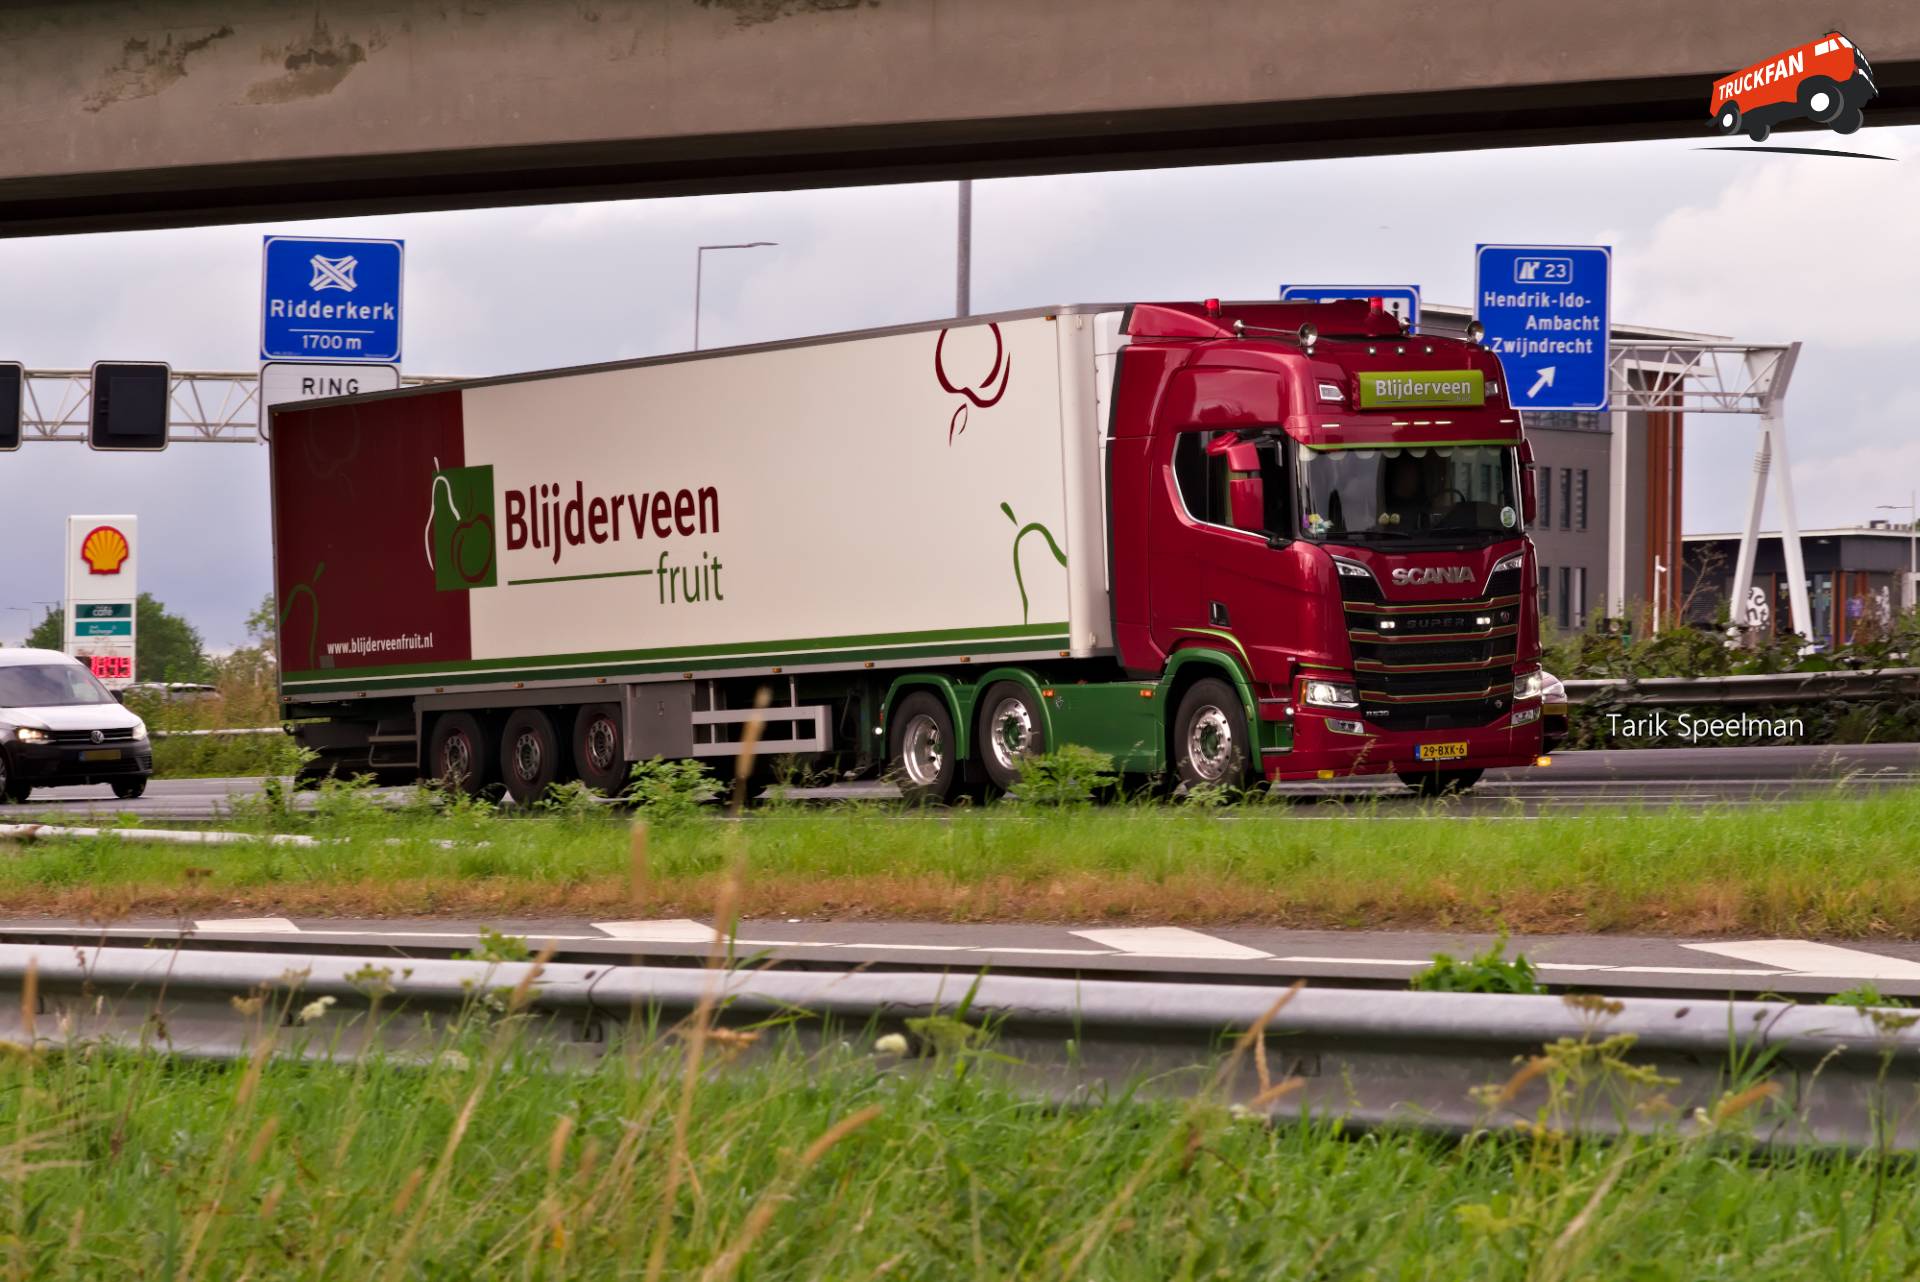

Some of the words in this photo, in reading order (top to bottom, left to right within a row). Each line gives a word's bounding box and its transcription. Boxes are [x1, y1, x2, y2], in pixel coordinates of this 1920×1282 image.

[1544, 263, 1567, 278] 23
[1484, 291, 1591, 308] Hendrik-Ido-
[270, 299, 395, 320] Ridderkerk
[1525, 315, 1600, 330] Ambacht
[302, 335, 342, 349] 1700
[345, 337, 362, 350] m
[1491, 337, 1593, 358] Zwijndrecht
[302, 377, 360, 396] RING
[1375, 378, 1471, 400] Blijderveen
[505, 480, 720, 565] Blijderveen
[656, 551, 724, 604] fruit
[1392, 566, 1476, 586] SCANIA
[1406, 618, 1465, 630] SUPER
[326, 632, 433, 656] www.blijderveenfruit.nl
[1423, 743, 1465, 757] 29-BXK-6
